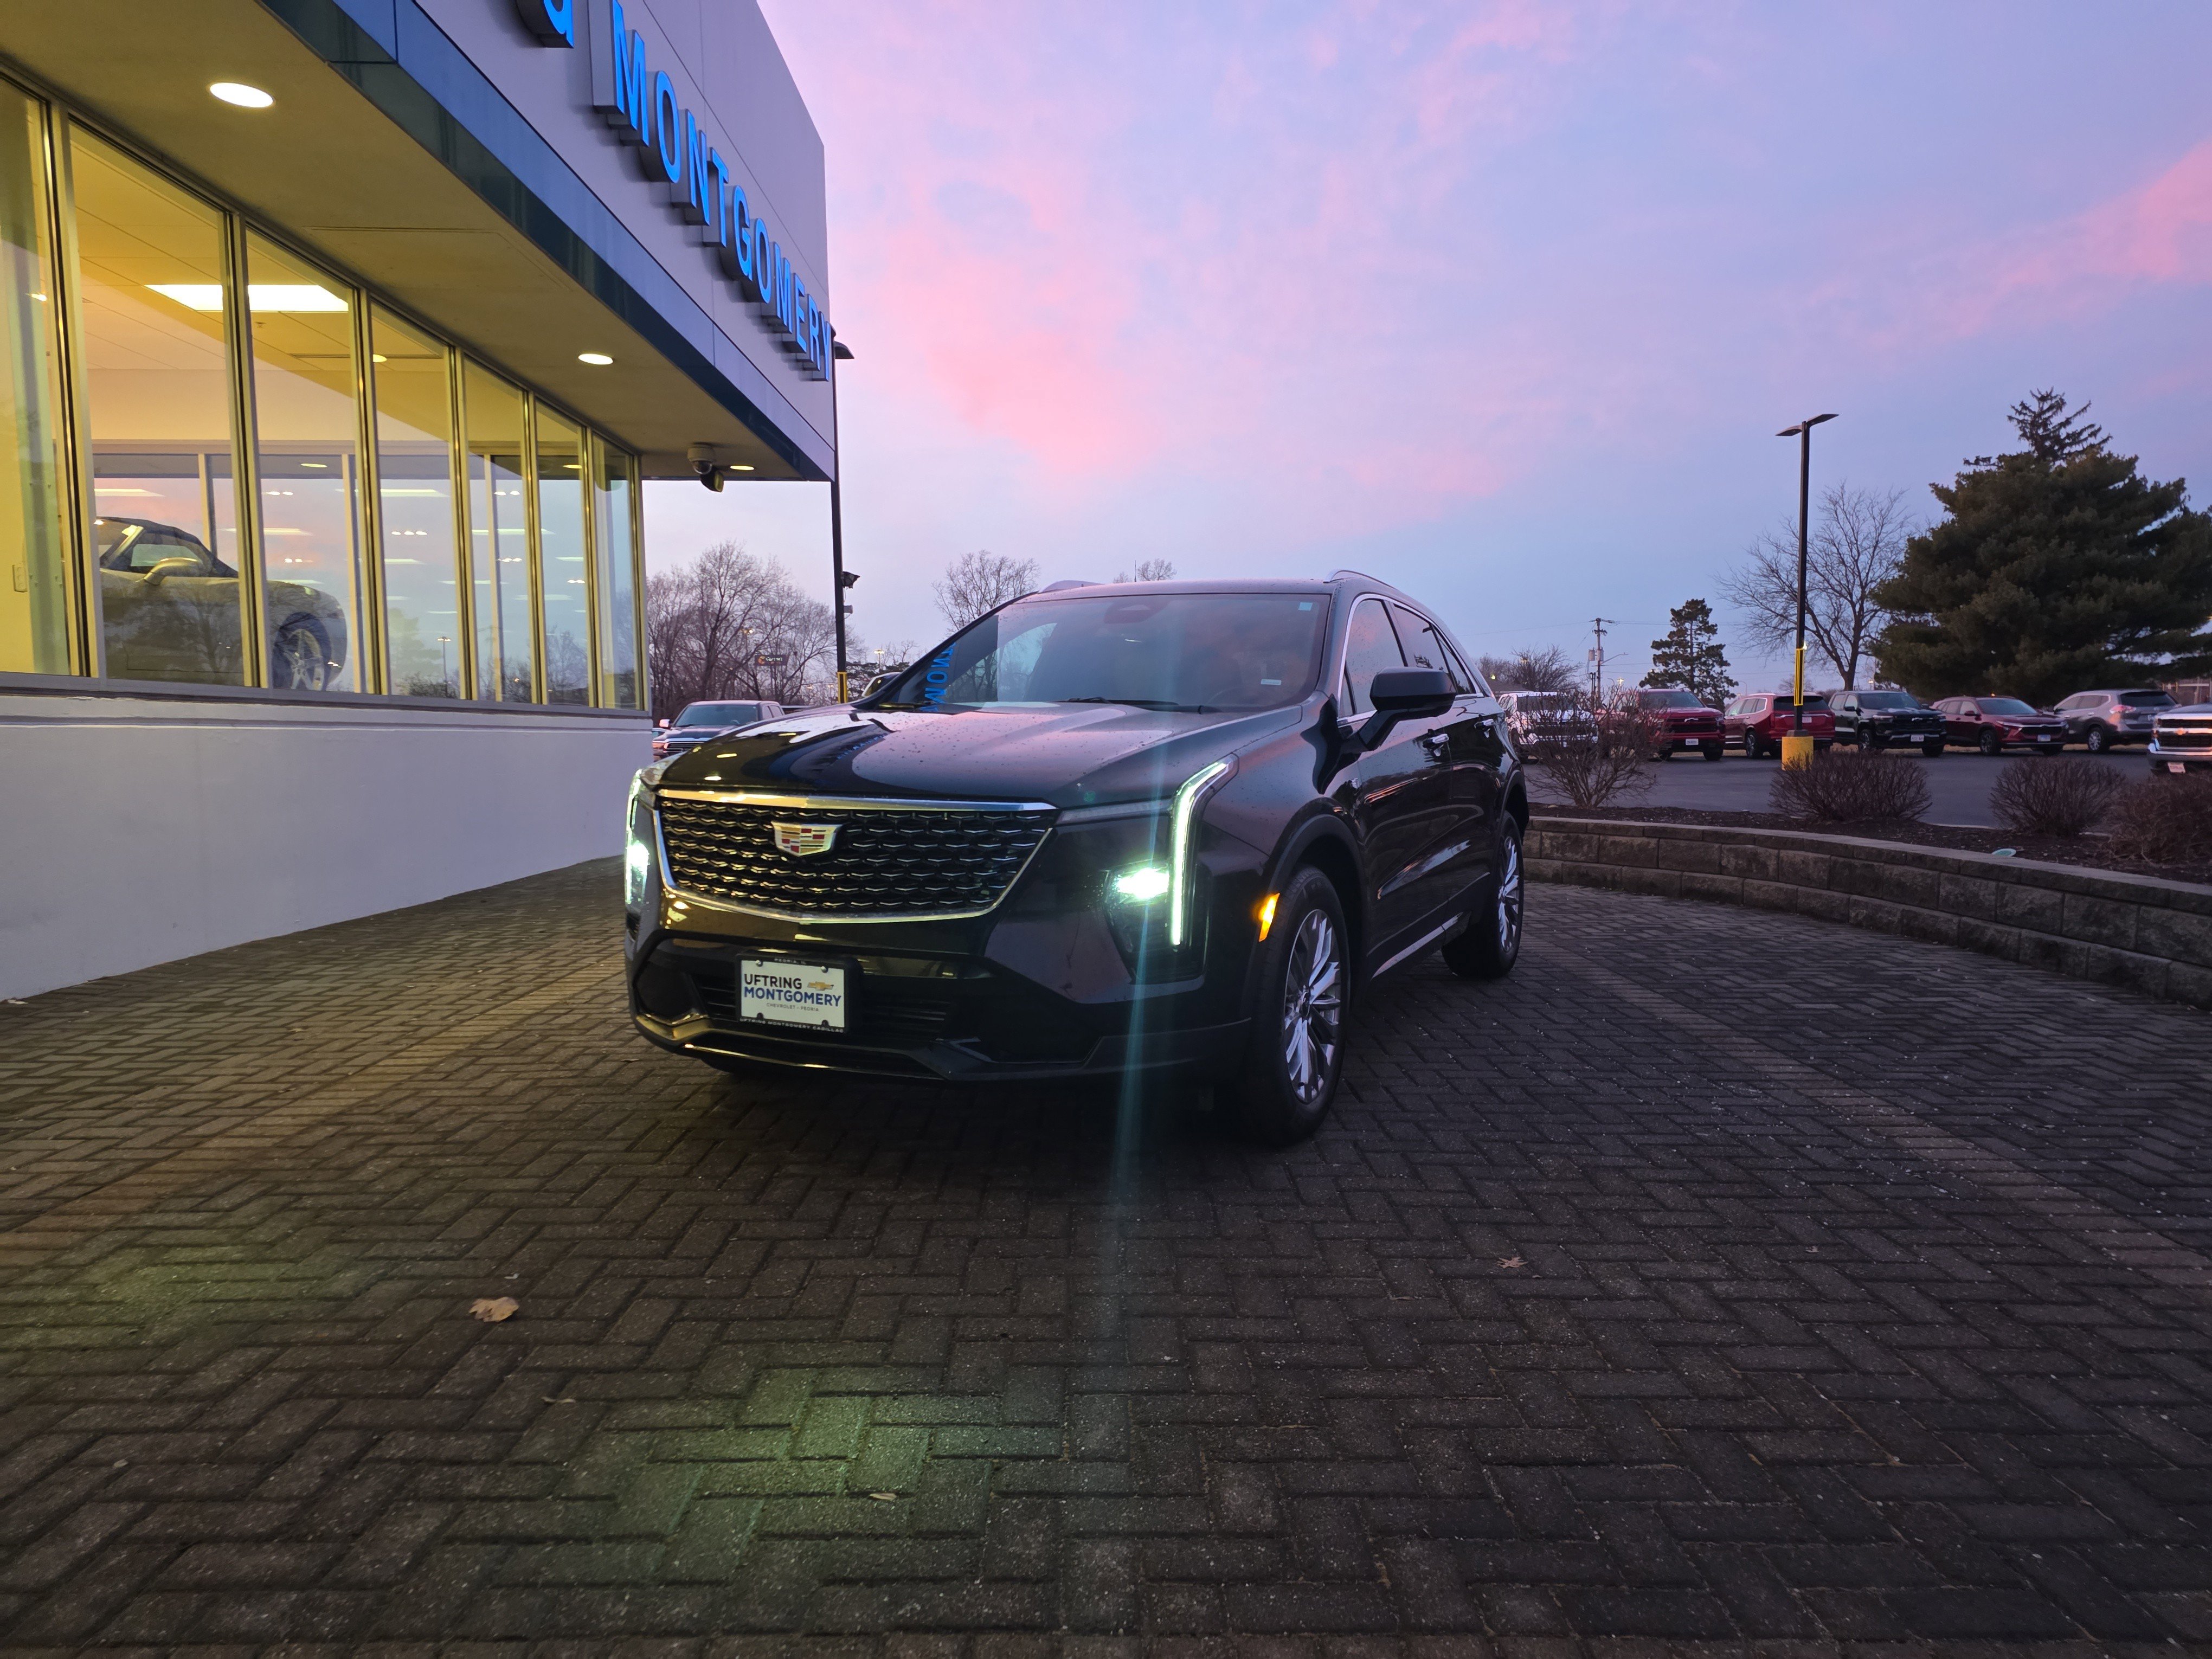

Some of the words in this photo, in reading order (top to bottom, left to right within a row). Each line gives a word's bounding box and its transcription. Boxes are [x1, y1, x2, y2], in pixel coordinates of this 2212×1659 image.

[613, 0, 832, 382] MONTGOMERY
[744, 974, 802, 989] UFTRING
[744, 986, 841, 1007] MONTGOMERY
[768, 1021, 810, 1029] MONTGOMERY
